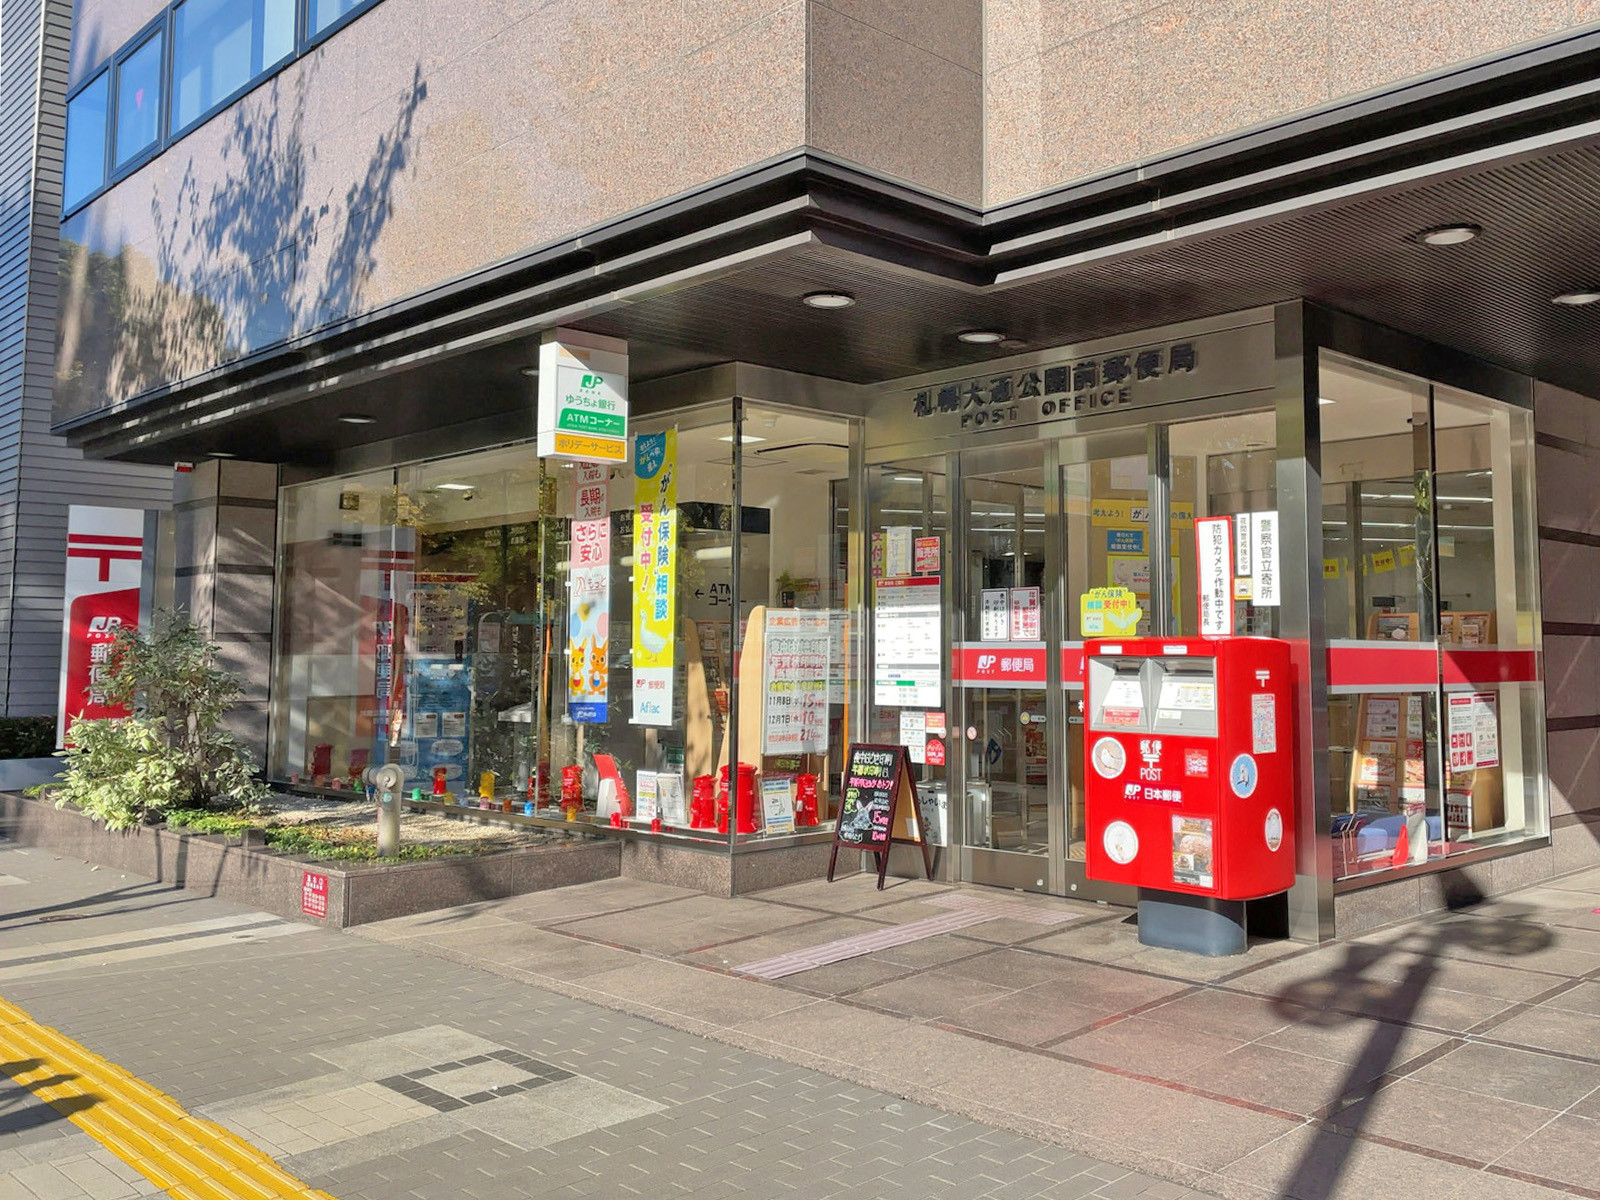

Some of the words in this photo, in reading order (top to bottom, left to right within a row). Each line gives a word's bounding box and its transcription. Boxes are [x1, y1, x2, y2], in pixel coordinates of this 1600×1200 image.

[566, 394, 616, 411] ゆうちょ銀行
[961, 406, 1018, 429] POST
[1041, 388, 1133, 417] OFFICE
[566, 413, 620, 427] ATMコーナー
[559, 439, 622, 454] ホリデーサービス
[576, 523, 606, 541] さらに
[580, 543, 602, 562] 安心
[1260, 519, 1273, 600] 警察官立寄所
[1211, 523, 1224, 631] 防犯カメラ作動中です
[978, 655, 996, 669] JP
[1001, 657, 1034, 673] 郵便局
[640, 701, 660, 714] Aflac
[1139, 739, 1162, 756] 郵便
[1139, 767, 1162, 782] POST
[1124, 784, 1141, 796] JP
[1144, 788, 1182, 804] 日本郵便
